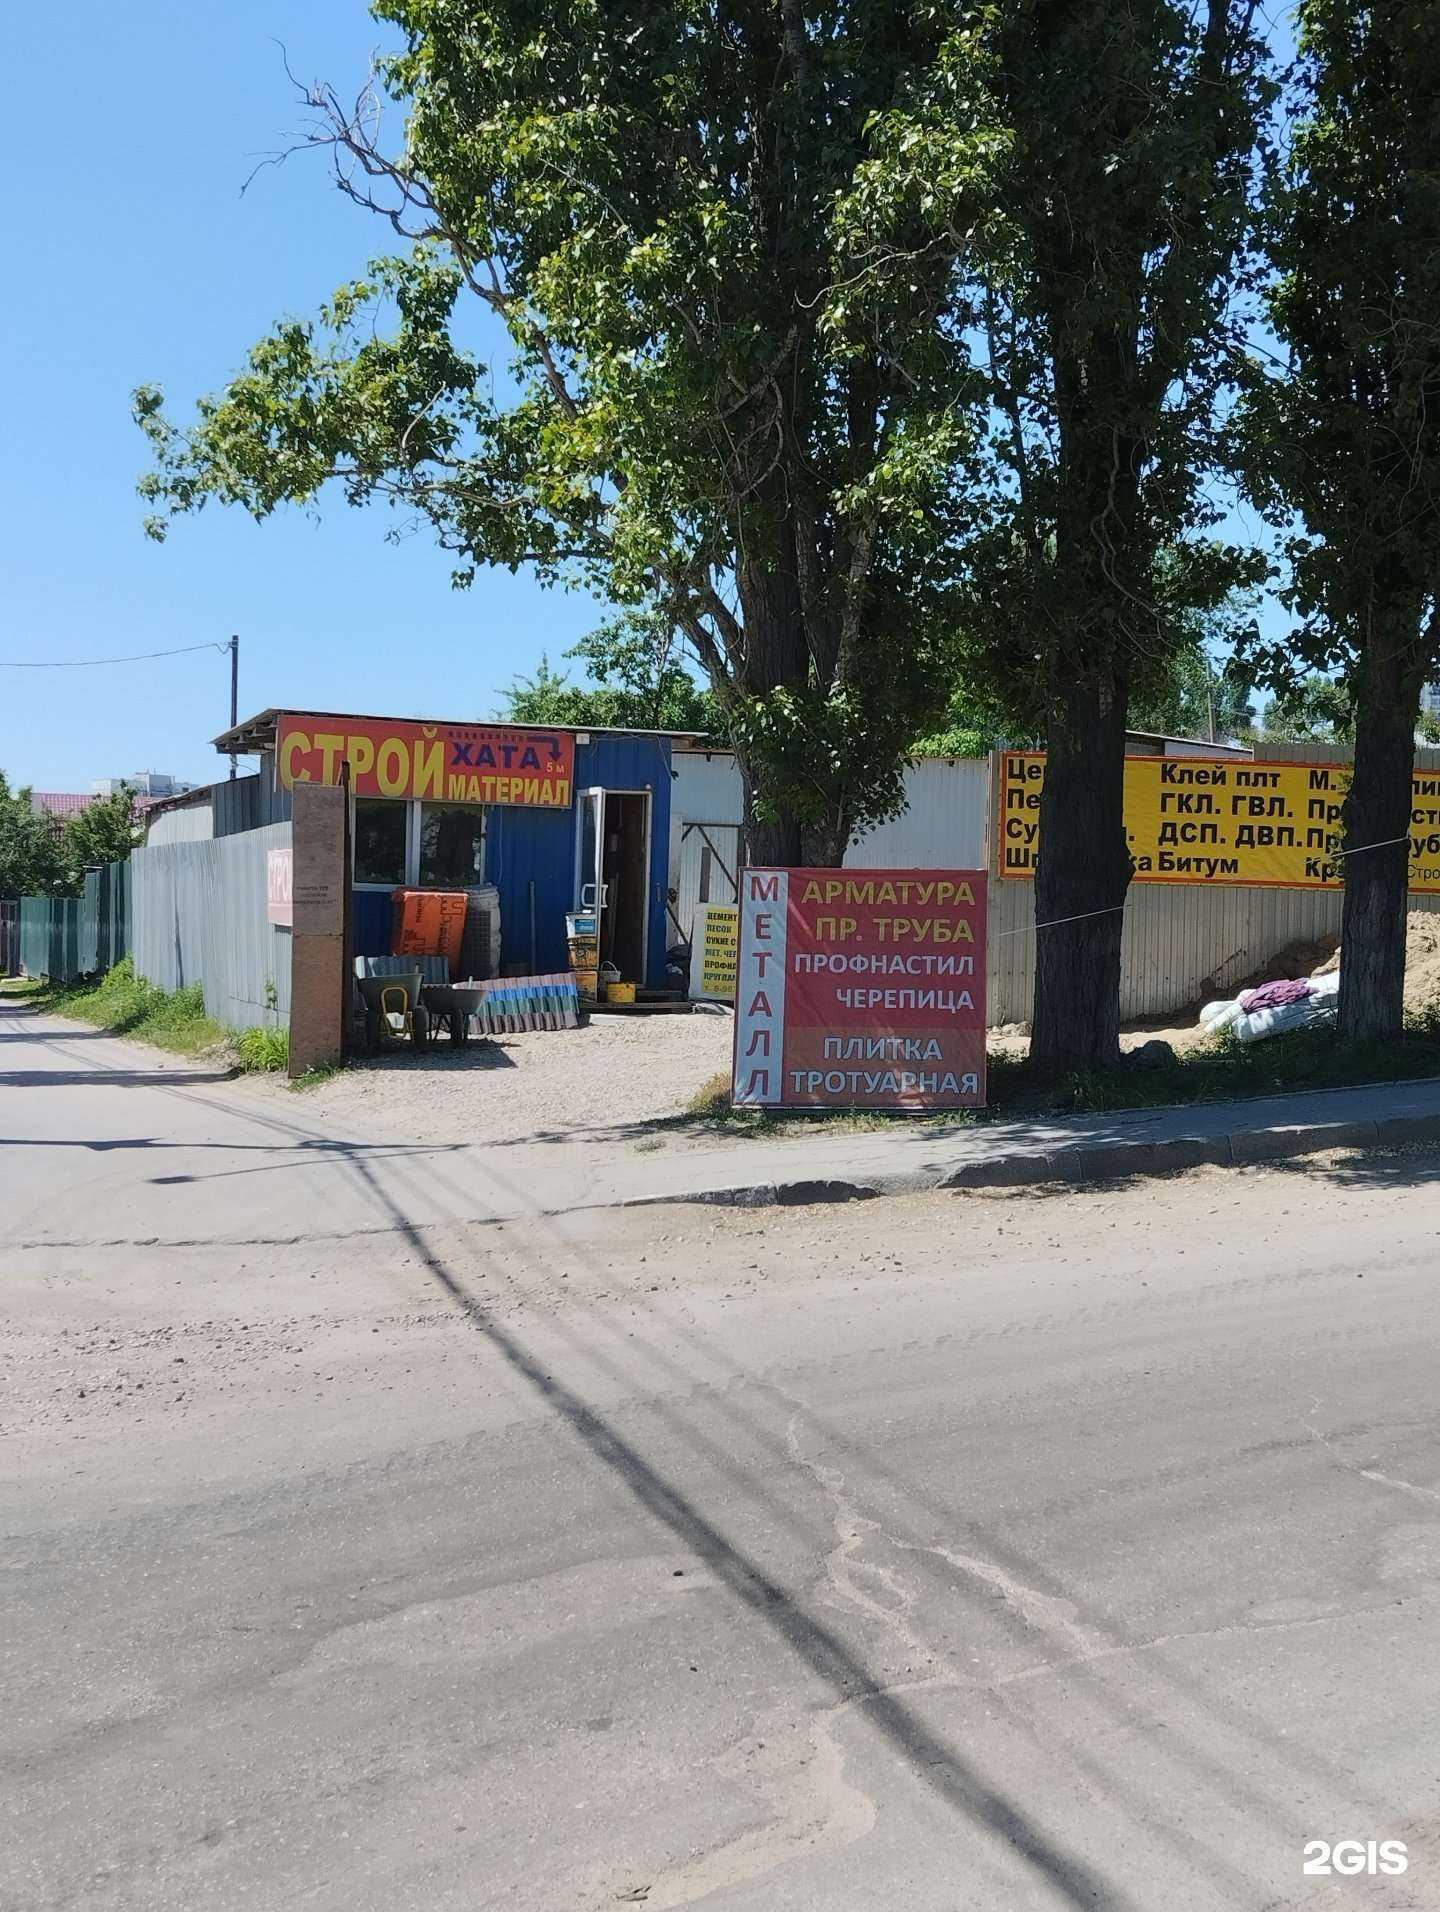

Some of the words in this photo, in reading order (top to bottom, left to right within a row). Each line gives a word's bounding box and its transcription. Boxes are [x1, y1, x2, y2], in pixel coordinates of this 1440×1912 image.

[280, 727, 444, 800] СТРОЙ
[451, 742, 541, 769] ХАТА
[1161, 763, 1227, 786] Клей
[1236, 771, 1280, 788] плт
[448, 774, 570, 806] МАТЕРИАЛ
[1160, 792, 1221, 815] ГКЛ.
[1232, 795, 1294, 818] ГВЛ.
[1158, 822, 1226, 847] ДСП.
[1235, 825, 1303, 849] ДВП.
[1158, 851, 1239, 878] Битум
[801, 880, 976, 905] АРМАТУРА
[816, 917, 863, 942] ПР.
[873, 918, 975, 943] ТРУБА
[794, 953, 974, 976] ПРОФНАСТИЛ
[746, 876, 779, 1096] МЕТАЛЛ
[836, 988, 975, 1014] ЧЕРЕПИЦА
[823, 1037, 943, 1061] ПЛИТКА
[790, 1070, 979, 1094] ТРОТУАРНАЯ
